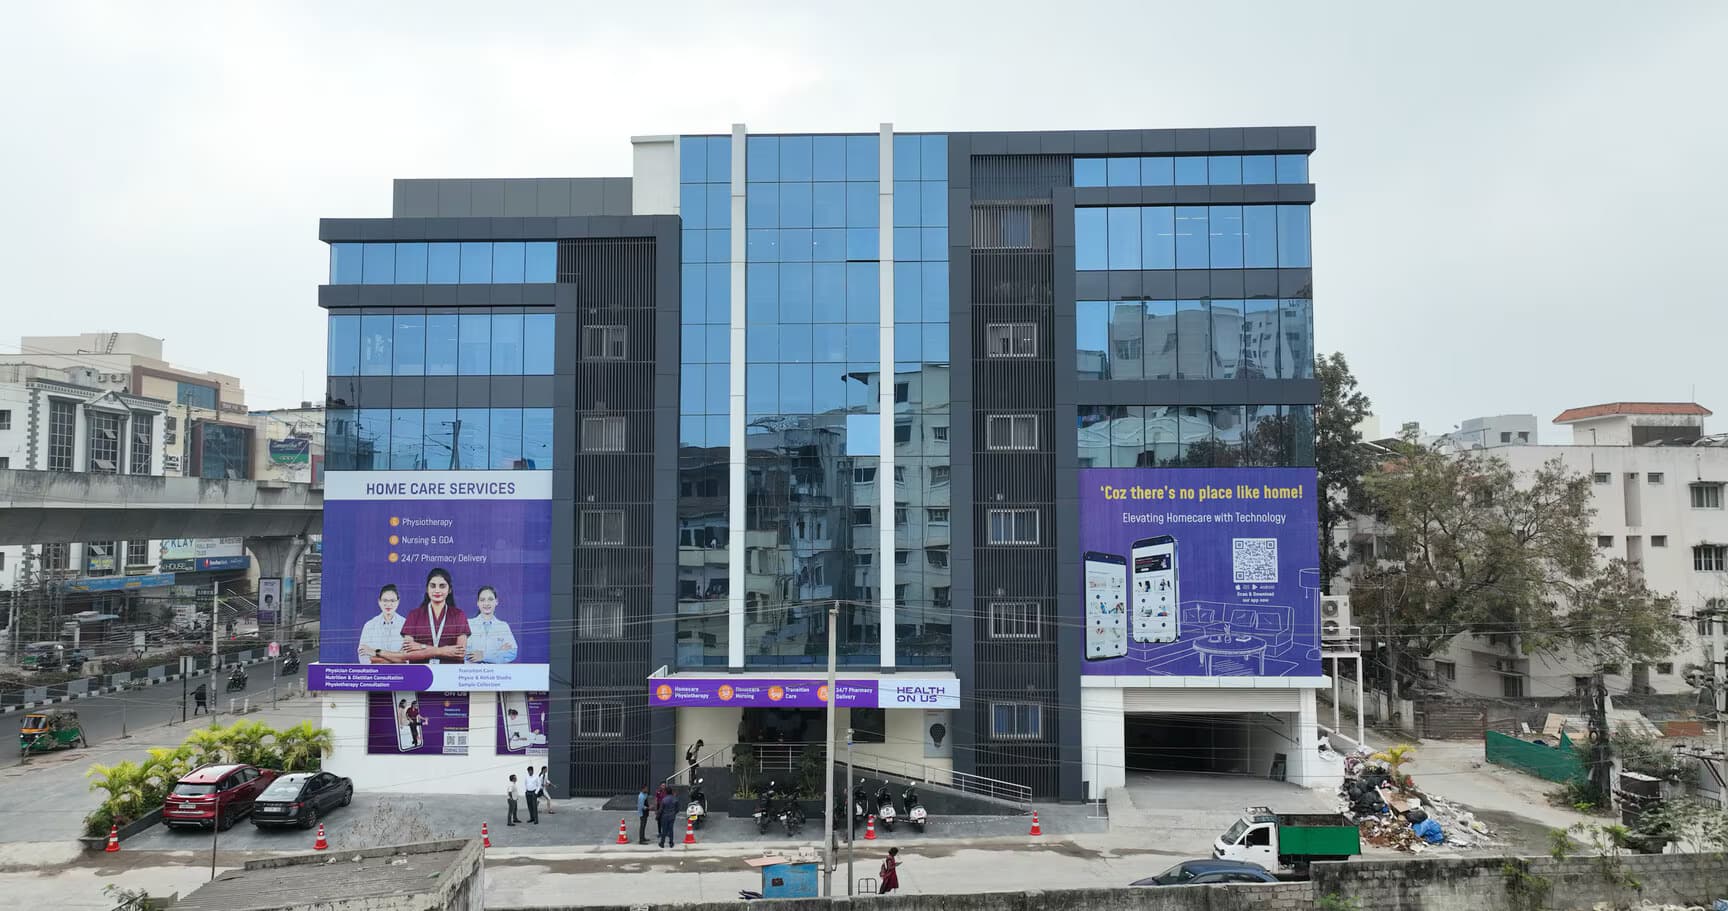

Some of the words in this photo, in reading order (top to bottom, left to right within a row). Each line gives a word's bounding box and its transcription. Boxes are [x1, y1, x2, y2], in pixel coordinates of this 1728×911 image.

[366, 483, 406, 495] HOME
[410, 483, 445, 495] CARE
[450, 482, 516, 495] SERVICES
[1131, 486, 1175, 499] there's
[1180, 488, 1194, 499] no
[1199, 486, 1232, 501] place
[1237, 485, 1259, 499] like
[1264, 485, 1303, 498] home!
[402, 518, 453, 527] Physiotherapy
[1122, 512, 1164, 524] Elevating
[1167, 513, 1211, 523] Homecare
[1214, 512, 1233, 522] with
[1236, 512, 1286, 524] Technology
[402, 536, 429, 545] Nursing
[401, 554, 420, 562] 24/7
[421, 554, 456, 563] Pharmacy
[458, 554, 487, 563] Delivery
